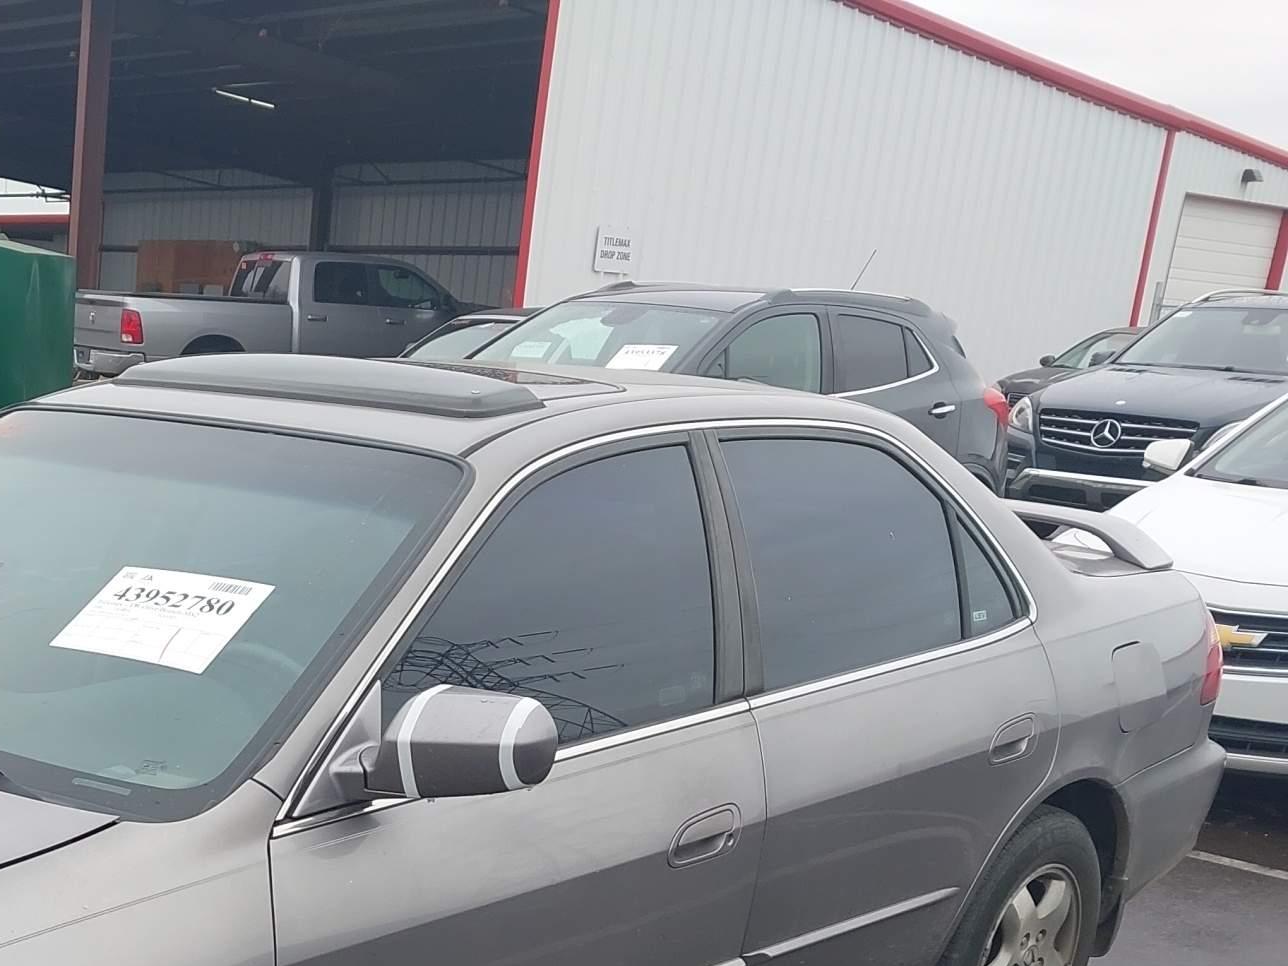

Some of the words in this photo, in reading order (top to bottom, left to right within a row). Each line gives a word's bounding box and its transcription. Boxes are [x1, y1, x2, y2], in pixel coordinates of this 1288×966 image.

[604, 237, 631, 248] TITLEMAX
[600, 249, 616, 260] DROP
[616, 251, 631, 262] ZONE
[113, 585, 236, 616] 43952780
